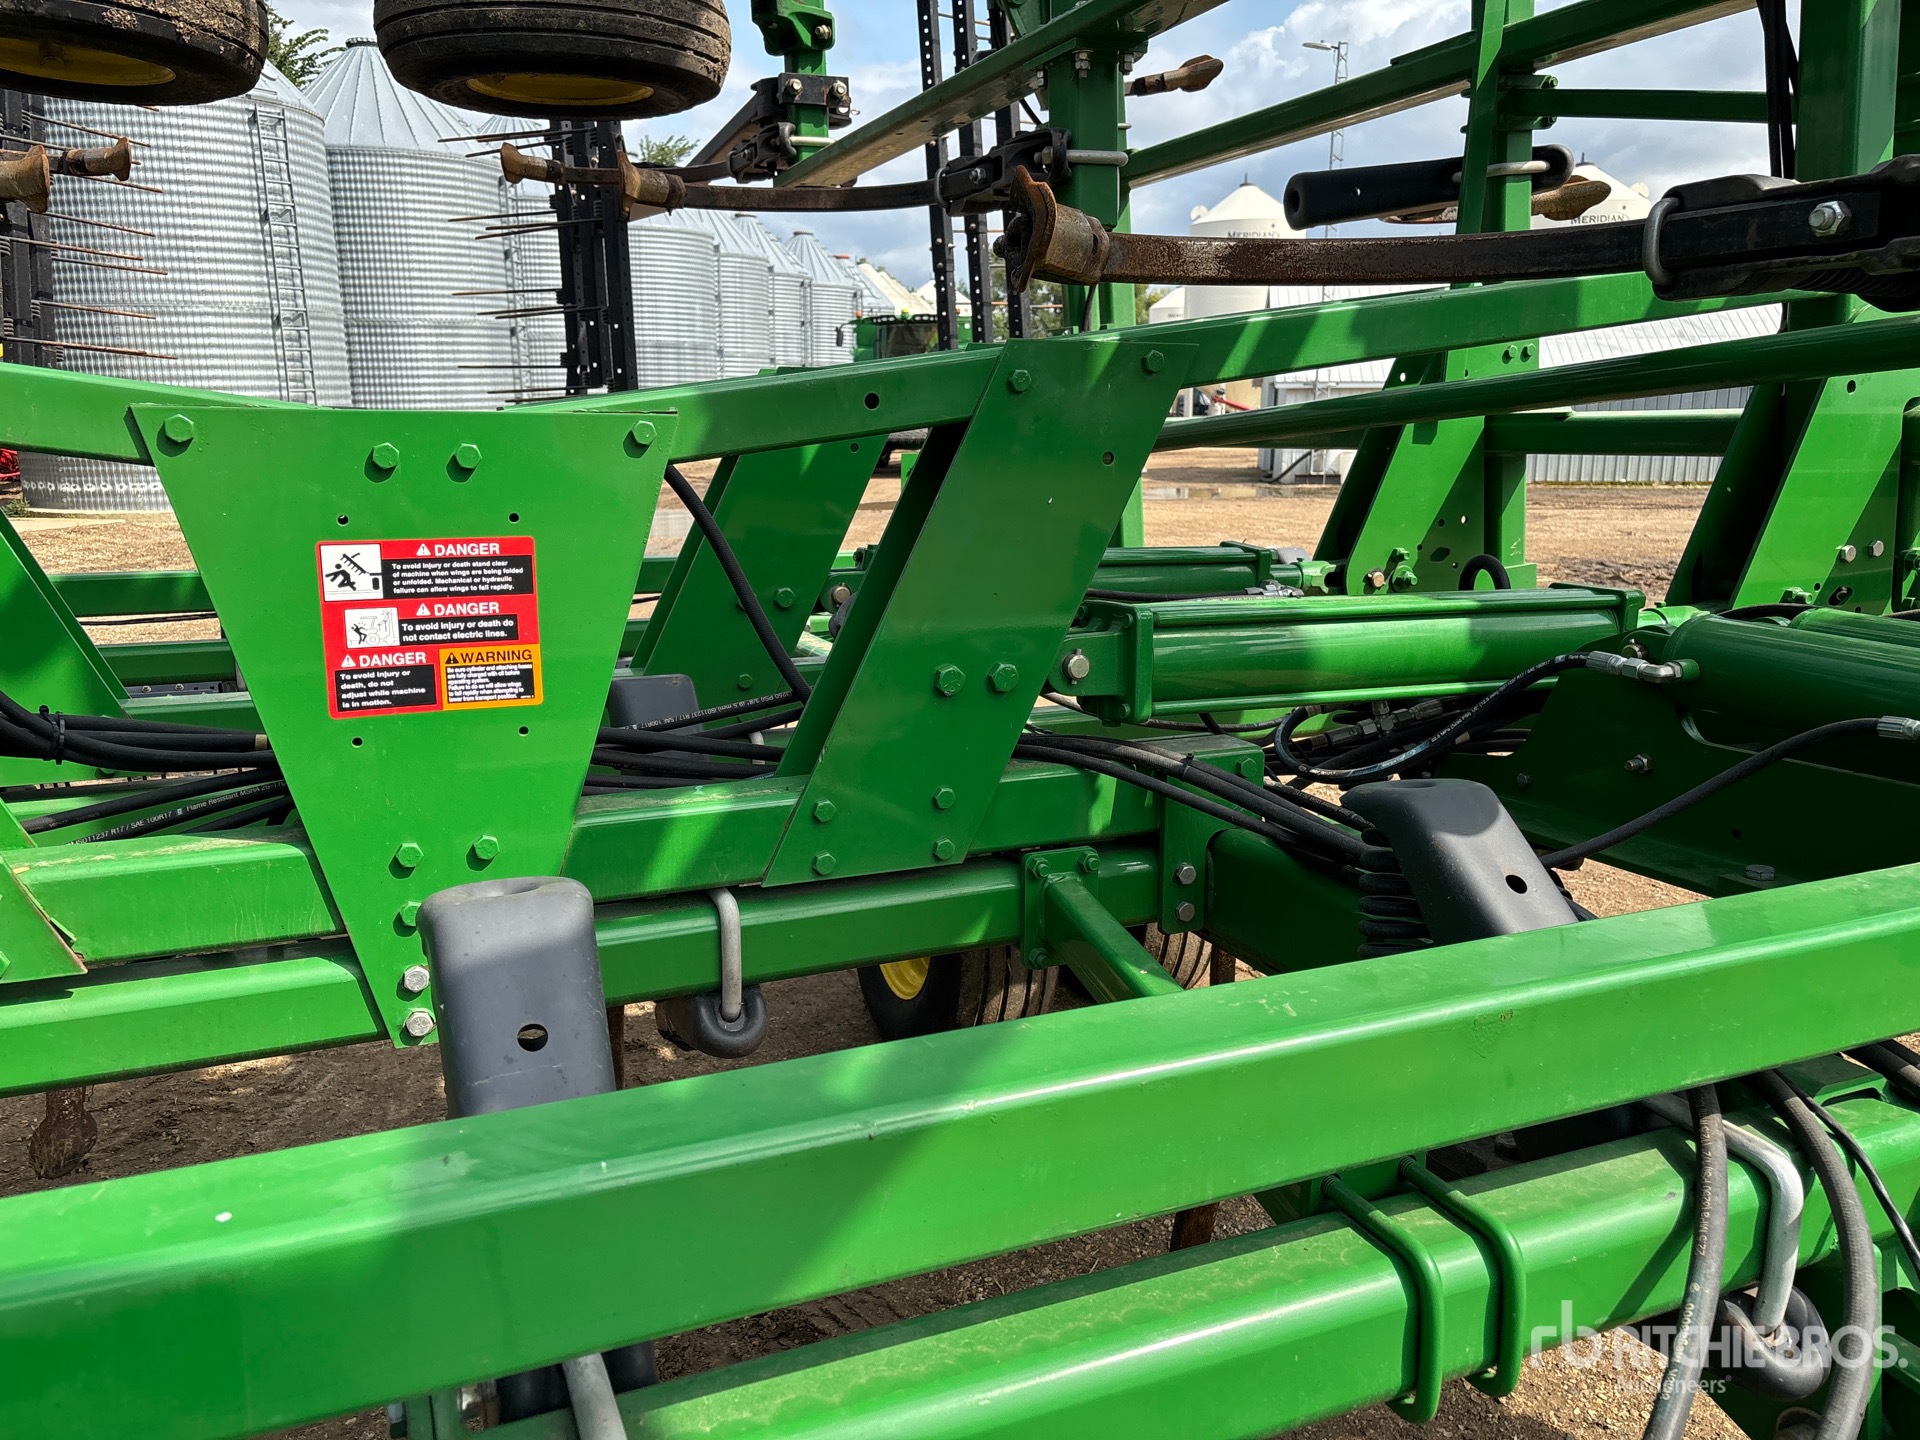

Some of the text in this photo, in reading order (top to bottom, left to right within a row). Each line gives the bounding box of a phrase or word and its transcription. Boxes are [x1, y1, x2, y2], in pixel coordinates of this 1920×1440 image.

[1570, 214, 1625, 225] MERIDIAN
[434, 543, 500, 556] DANGER
[401, 570, 430, 578] machine
[449, 585, 470, 593] wings
[490, 583, 515, 591] rapidly.
[434, 602, 500, 616] DANGER
[402, 623, 414, 631] To
[415, 622, 439, 630] avoid
[440, 622, 465, 630] injury
[478, 619, 502, 628] death
[402, 630, 508, 642] not contact electric lines.
[359, 652, 427, 668] DANGER
[460, 649, 532, 664] WARNING
[376, 671, 400, 679] injury
[340, 682, 366, 690] death,
[342, 692, 367, 700] adjust
[110, 826, 124, 836] R17
[130, 820, 145, 830] SAE
[146, 811, 172, 824] 100R17
[208, 793, 239, 805] Resistant
